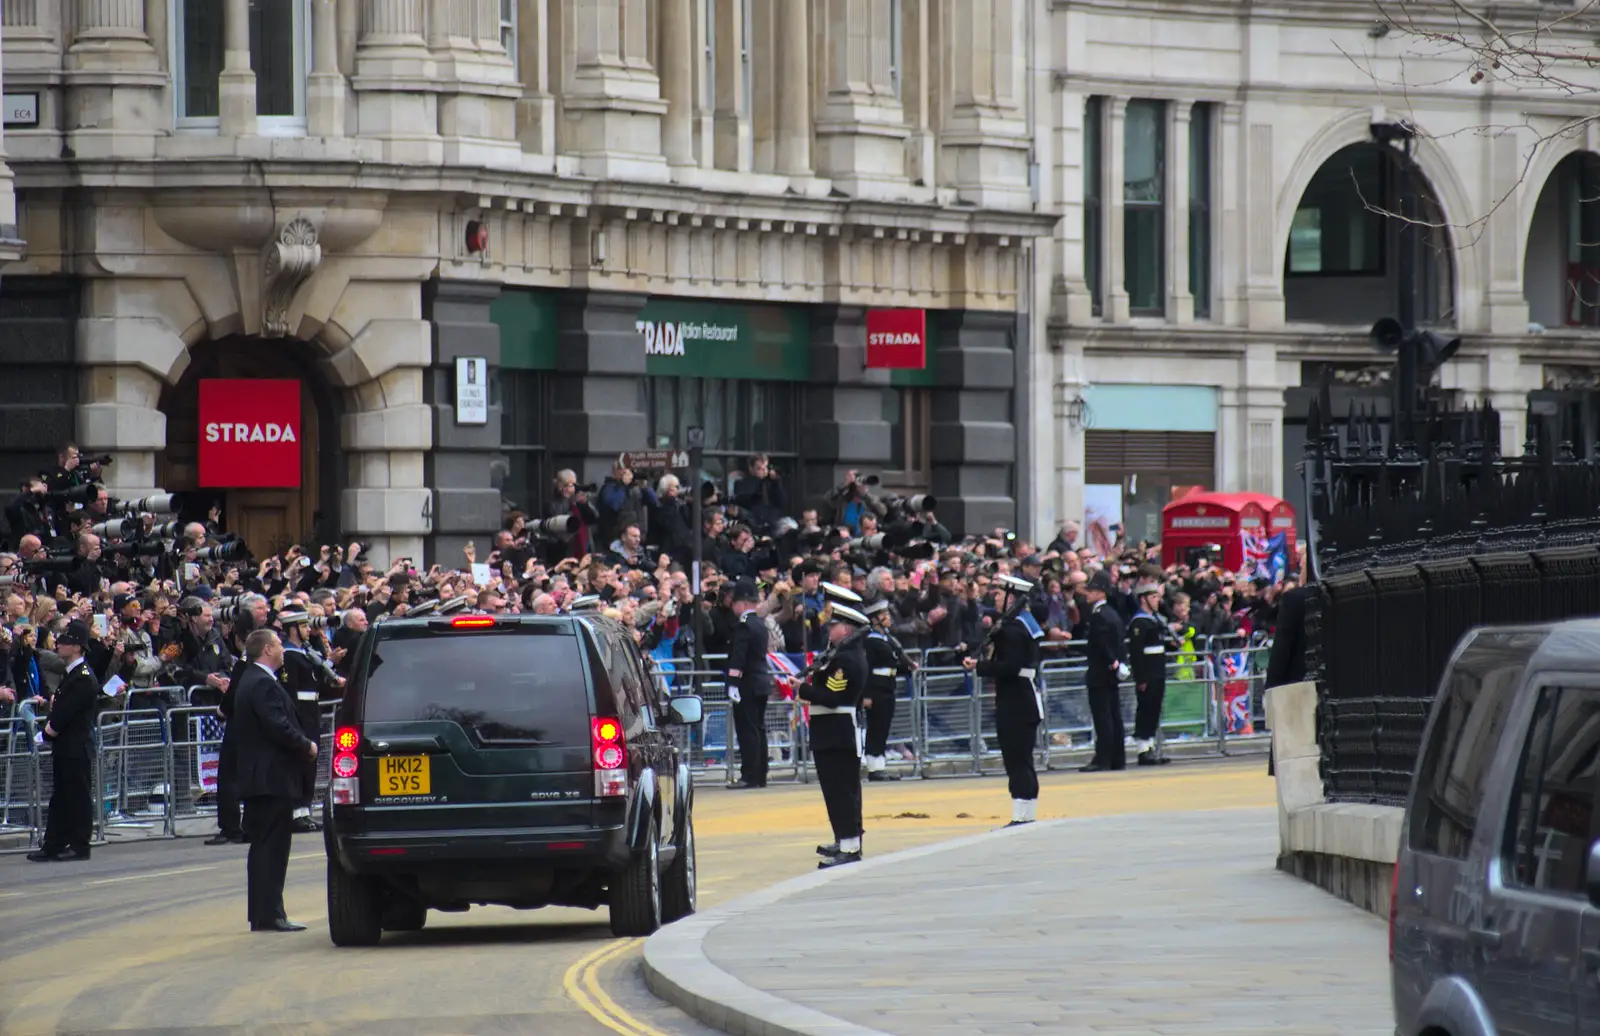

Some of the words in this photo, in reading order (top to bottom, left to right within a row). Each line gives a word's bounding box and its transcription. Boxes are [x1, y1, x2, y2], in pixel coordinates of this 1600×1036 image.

[14, 109, 31, 119] EC4
[702, 321, 738, 341] Restaurant
[870, 332, 921, 346] STRADA
[206, 422, 296, 442] STRADA
[421, 495, 432, 529] 4
[387, 758, 422, 773] HK12
[389, 775, 420, 791] SYS
[374, 796, 437, 804] DISCOVERY
